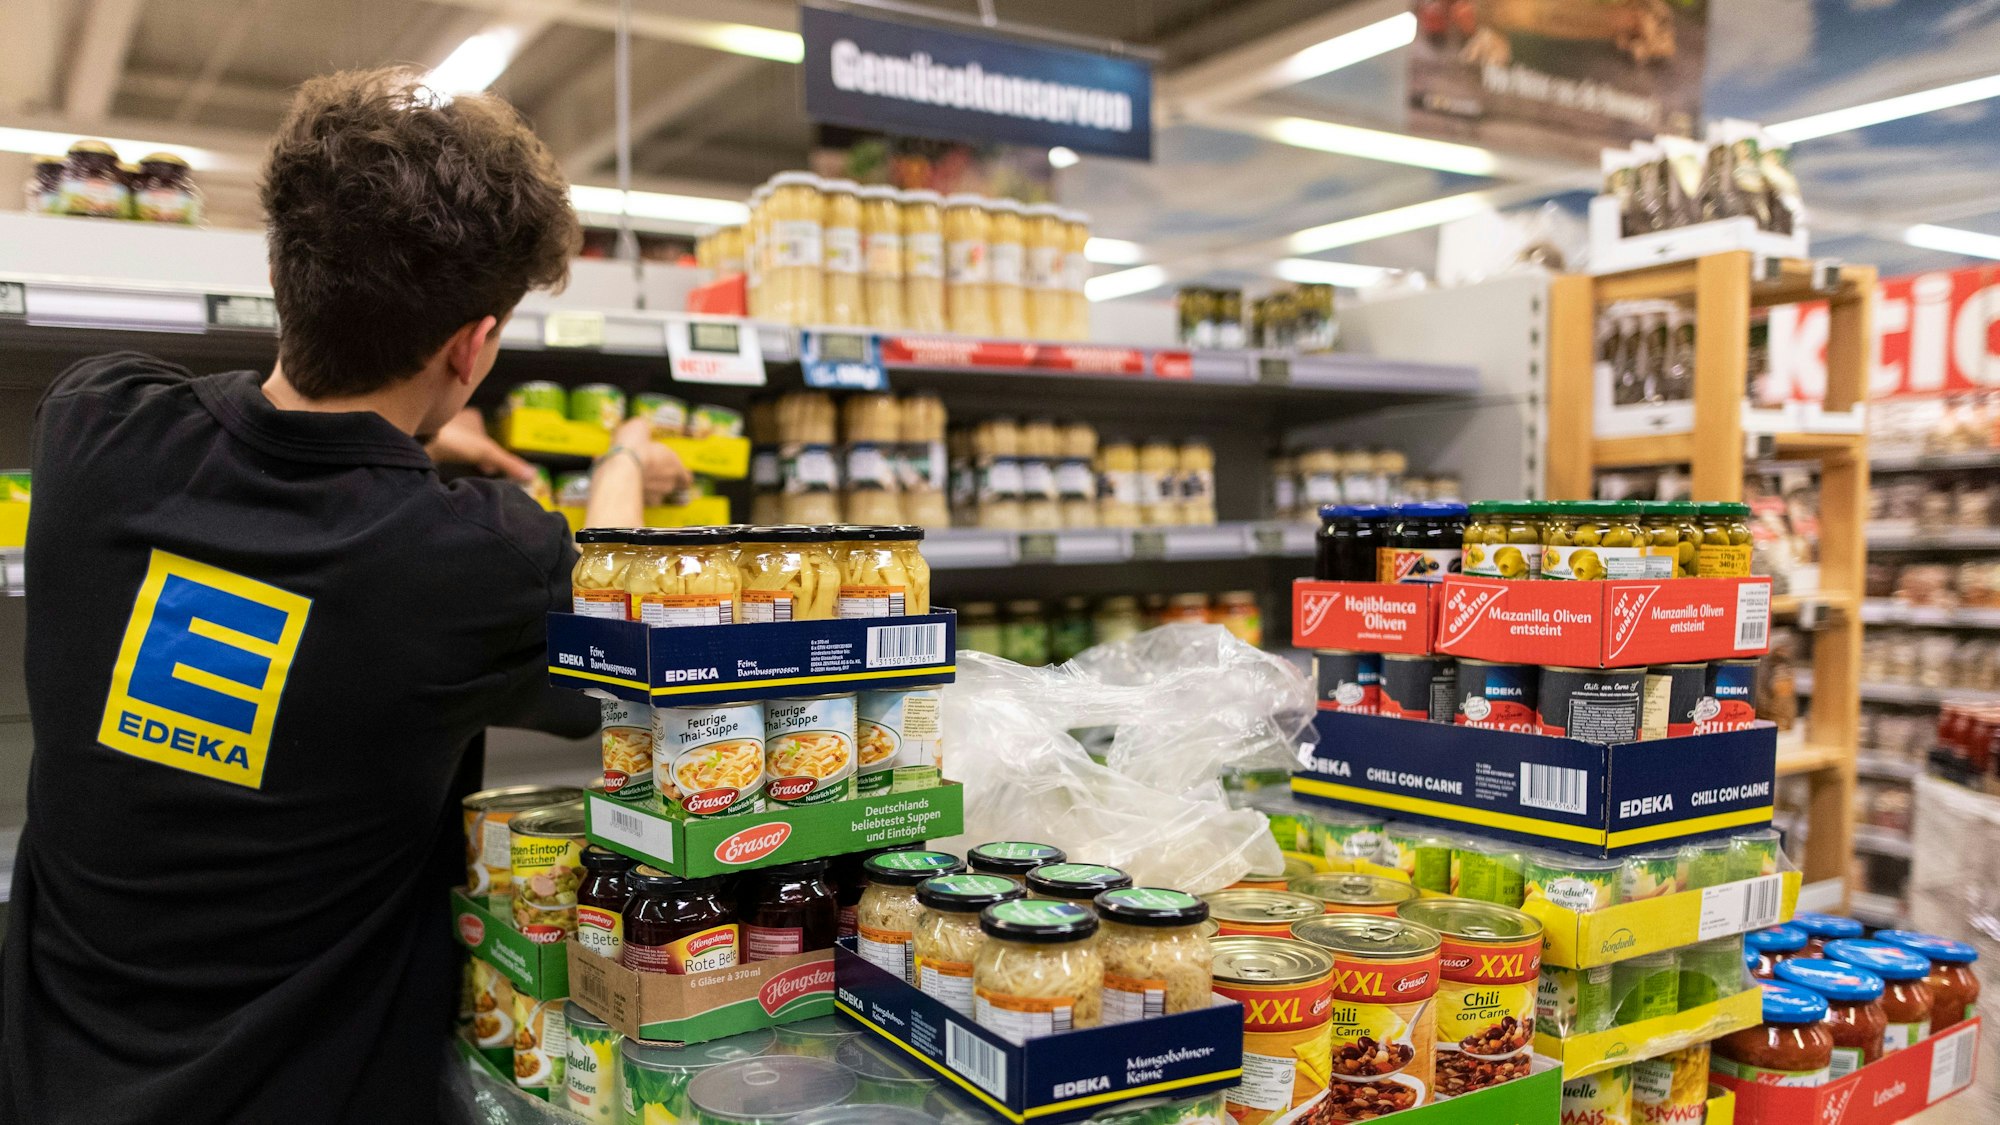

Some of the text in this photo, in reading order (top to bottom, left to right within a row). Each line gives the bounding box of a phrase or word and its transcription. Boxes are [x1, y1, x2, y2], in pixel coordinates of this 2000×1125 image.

[831, 39, 1132, 132] Gemüsekonserven
[1344, 595, 1417, 616] Hojiblanca
[1448, 587, 1467, 610] GUT
[1458, 601, 1468, 612] &
[1613, 592, 1630, 617] GUT
[1448, 591, 1489, 634] GÜNSTIG
[1488, 606, 1592, 624] Mazanilla Oliven
[1615, 592, 1646, 642] GÜNSTIG
[1622, 608, 1630, 618] &
[1651, 603, 1725, 620] Manzanilla Oliven
[1364, 612, 1407, 631] Oliven
[1510, 623, 1562, 637] entsteint
[1670, 620, 1705, 634] entsteint
[558, 652, 585, 667] EDEKA
[590, 646, 605, 658] Feine
[878, 657, 906, 666] 311501
[909, 655, 935, 664] 351611
[590, 658, 637, 676] Bambussprossen
[737, 660, 758, 668] Feine
[737, 667, 800, 678] Bambussprossen
[665, 667, 719, 683] EDEKA
[1486, 686, 1522, 696] EDEKA
[1584, 682, 1600, 691] Chili
[1716, 686, 1748, 695] EDEKA
[687, 714, 727, 730] Feurige
[770, 706, 806, 720] Feurige
[764, 714, 818, 732] Thai-Suppe
[117, 709, 250, 770] EDEKA
[679, 722, 738, 744] Thai-Suppe
[1308, 756, 1352, 778] DEKA
[1366, 767, 1398, 785] CHILI
[1398, 772, 1424, 788] CON
[1424, 776, 1464, 796] CARNE
[770, 781, 814, 797] Erasco
[687, 791, 736, 812] Erasco
[865, 798, 929, 817] Deutschlands
[1619, 780, 1770, 819] EDEKA CHILI CON CARNE
[852, 810, 941, 832] beliebteste Suppen
[866, 824, 927, 843] und Eintöpfe
[725, 828, 786, 862] Erasco
[1547, 884, 1593, 898] Bonduelle
[578, 932, 620, 946] ote Bete
[690, 932, 734, 951] Hengstenberg
[1600, 935, 1636, 954] Bonduelle
[685, 956, 720, 972] Rote
[719, 949, 736, 966] Bete
[1475, 954, 1526, 978] XXL
[690, 967, 761, 988] 6 Gläser à 370 ml
[1332, 968, 1428, 997] XXL Erasco
[767, 969, 835, 1005] Hengsten
[838, 987, 865, 1012] EDEKA
[1464, 992, 1500, 1007] Chili
[1537, 997, 1558, 1007] bsen
[1244, 998, 1304, 1025] XXL
[1332, 1007, 1357, 1022] hili
[1456, 1008, 1510, 1021] con Carne
[1336, 1026, 1371, 1037] Carne
[566, 1050, 597, 1074] duelle
[1126, 1046, 1215, 1071] Mungobohnen-
[571, 1076, 597, 1094] Erbsen
[1126, 1068, 1164, 1085] Keime
[1053, 1075, 1111, 1099] EDEKA
[1563, 1084, 1597, 1099] uelle
